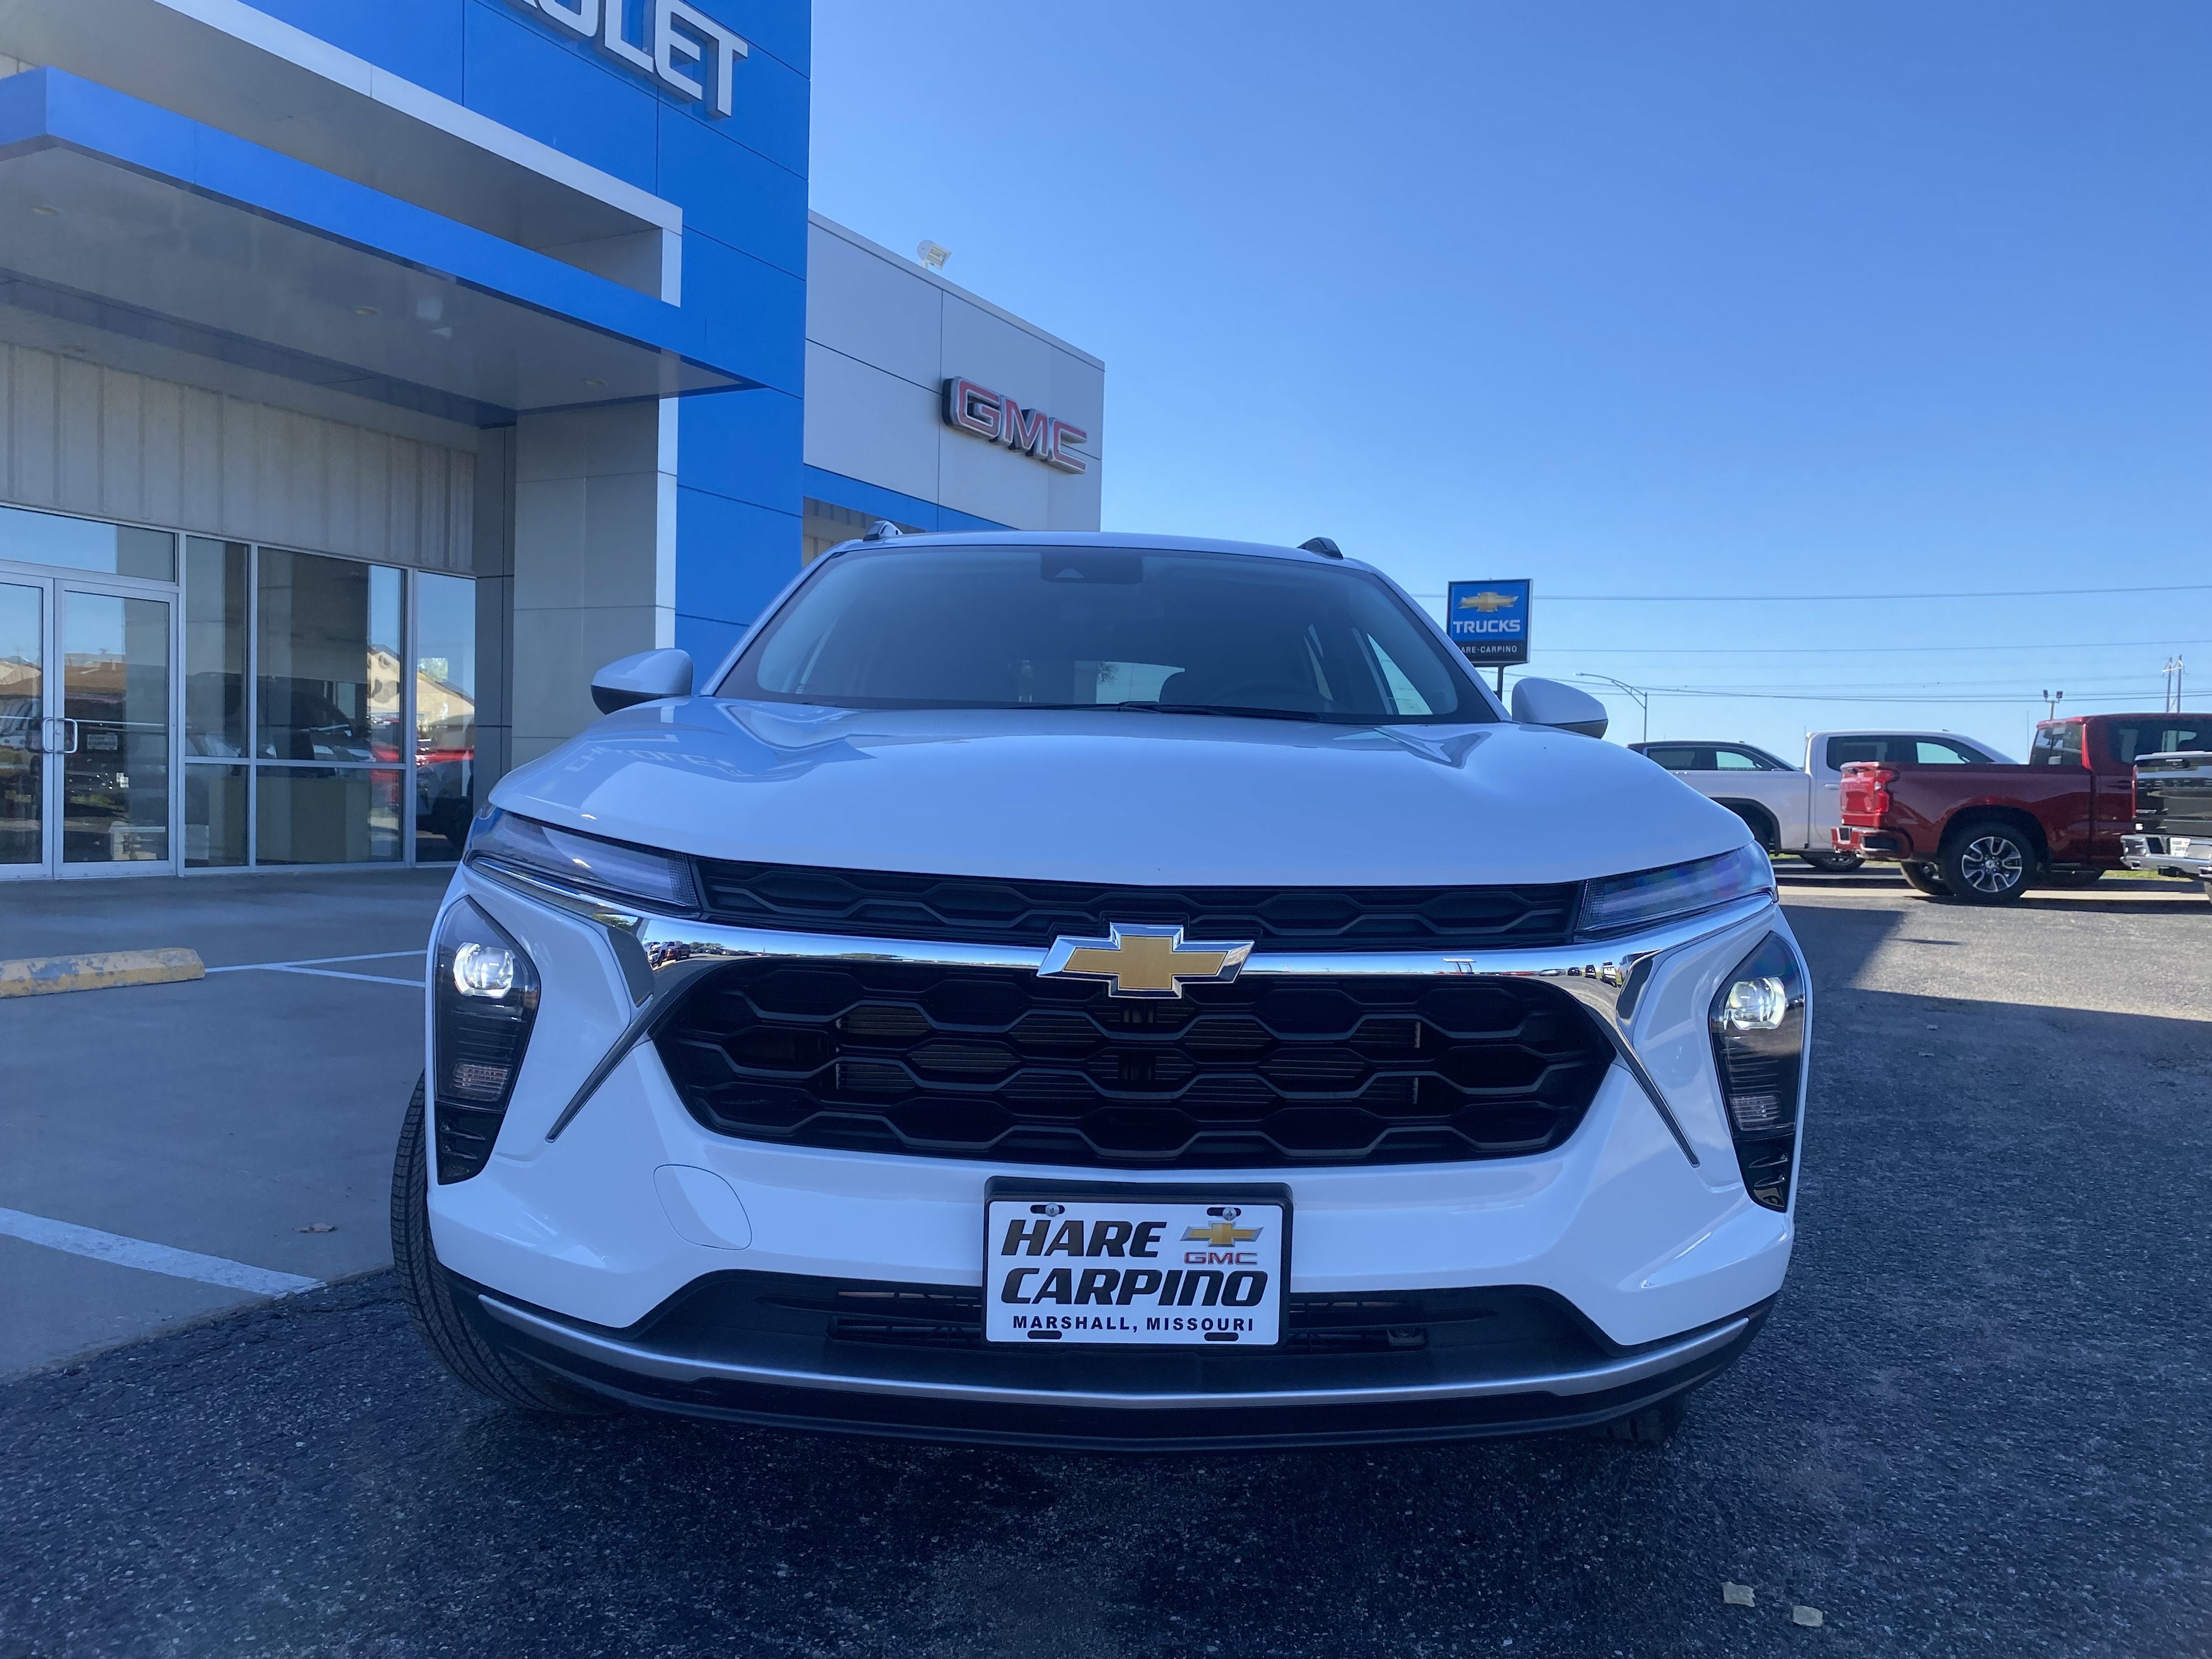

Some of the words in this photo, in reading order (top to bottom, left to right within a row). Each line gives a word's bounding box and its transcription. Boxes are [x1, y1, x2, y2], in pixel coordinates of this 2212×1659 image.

[942, 376, 1087, 475] GMC
[1453, 619, 1521, 634] TRUCKS
[1001, 1220, 1167, 1257] HARE
[1183, 1251, 1258, 1265] GMC
[1001, 1268, 1268, 1307] CARPINO
[1013, 1316, 1138, 1333] MARSHALL,
[1146, 1317, 1254, 1331] MISSOURI
